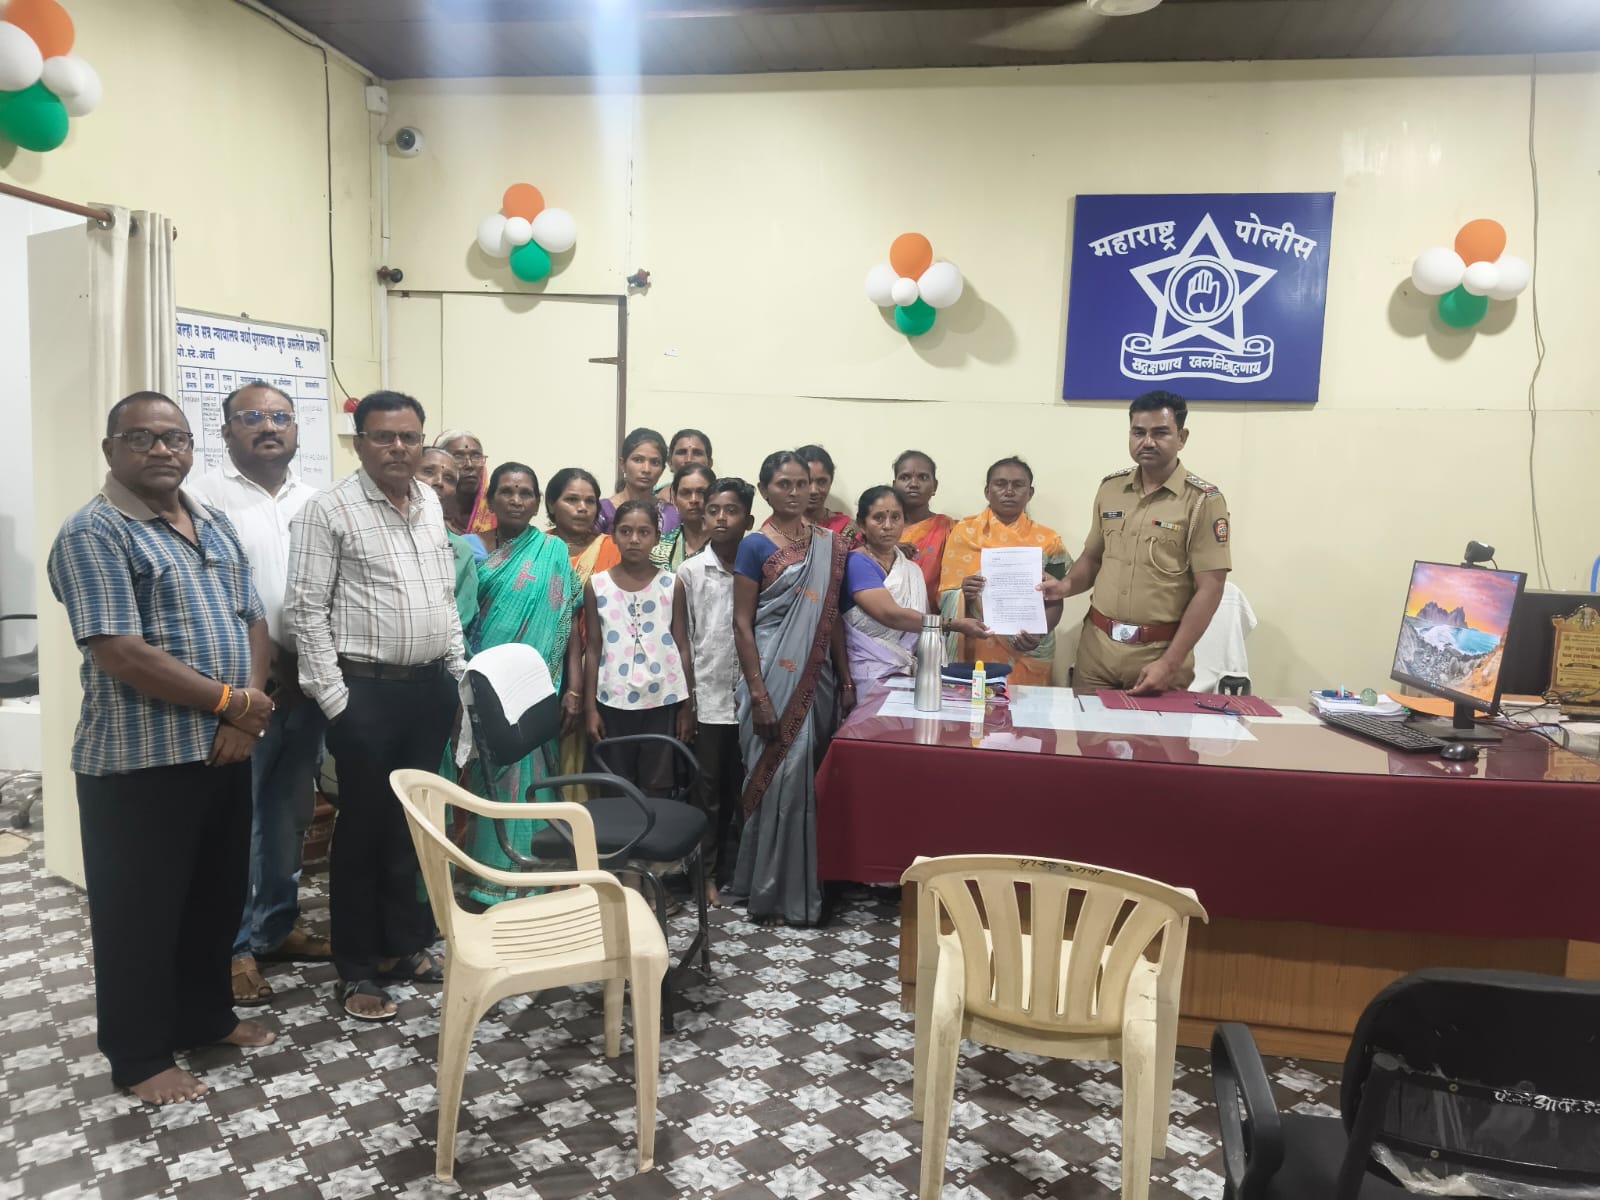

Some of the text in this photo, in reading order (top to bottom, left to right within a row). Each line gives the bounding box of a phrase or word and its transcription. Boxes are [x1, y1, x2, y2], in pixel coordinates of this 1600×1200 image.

[1088, 212, 1318, 261] महाराष्ट्र पोलीस
[1132, 352, 1262, 376] सद्रक्षणाय खलनिग्रहणाय
